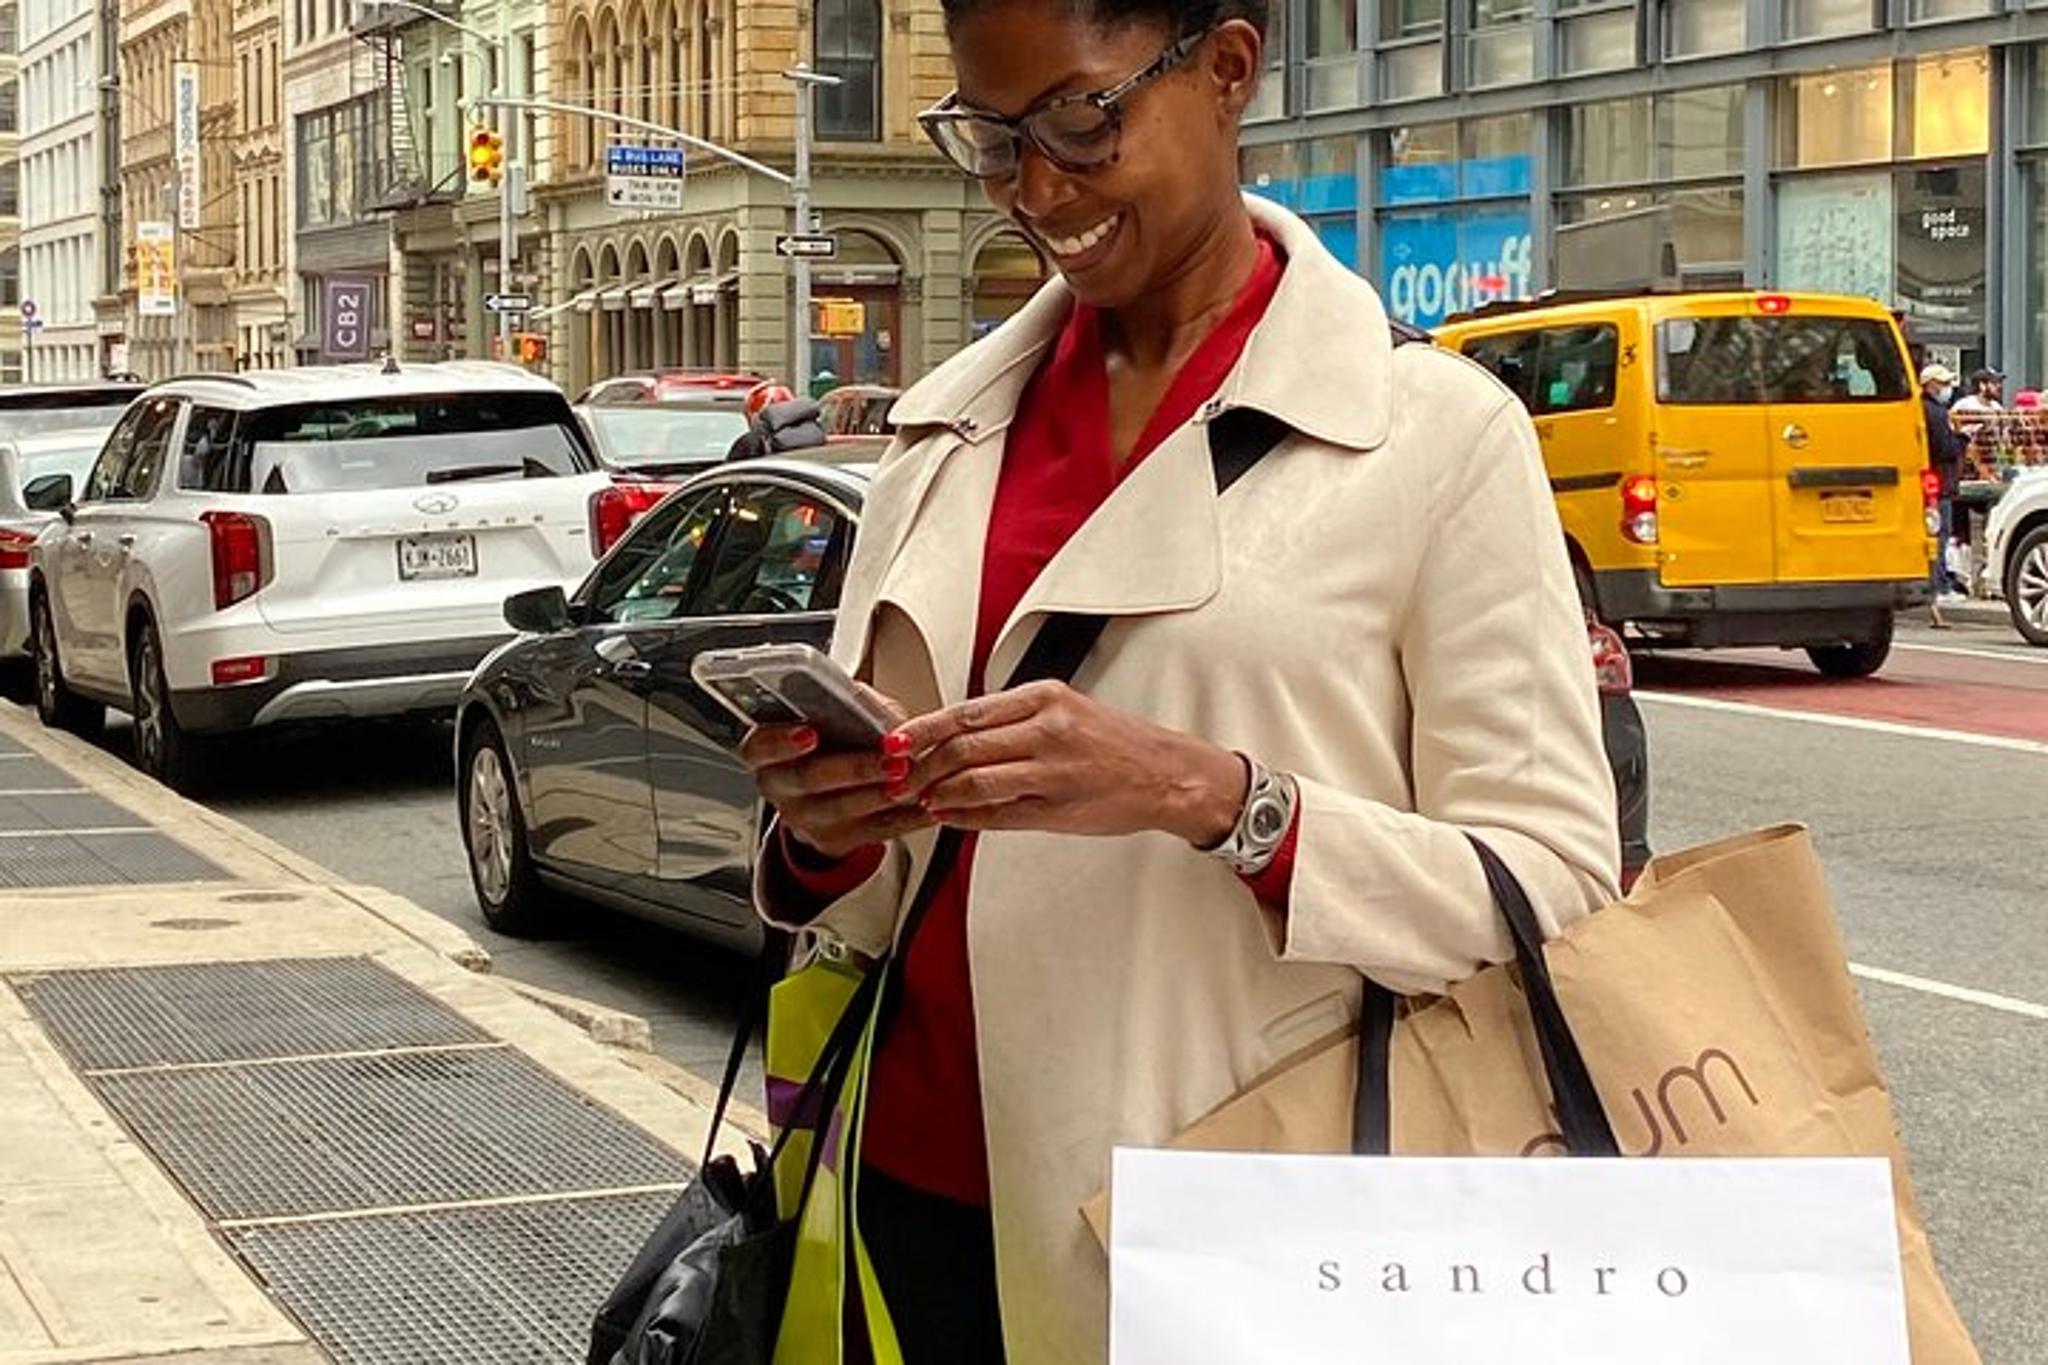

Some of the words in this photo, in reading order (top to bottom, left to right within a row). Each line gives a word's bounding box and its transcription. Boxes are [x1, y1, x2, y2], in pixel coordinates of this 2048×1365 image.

[651, 150, 680, 165] LANE
[651, 164, 680, 177] ONLY
[1922, 208, 1955, 229] good
[336, 294, 360, 348] CB2
[1317, 1252, 1689, 1297] sandro
